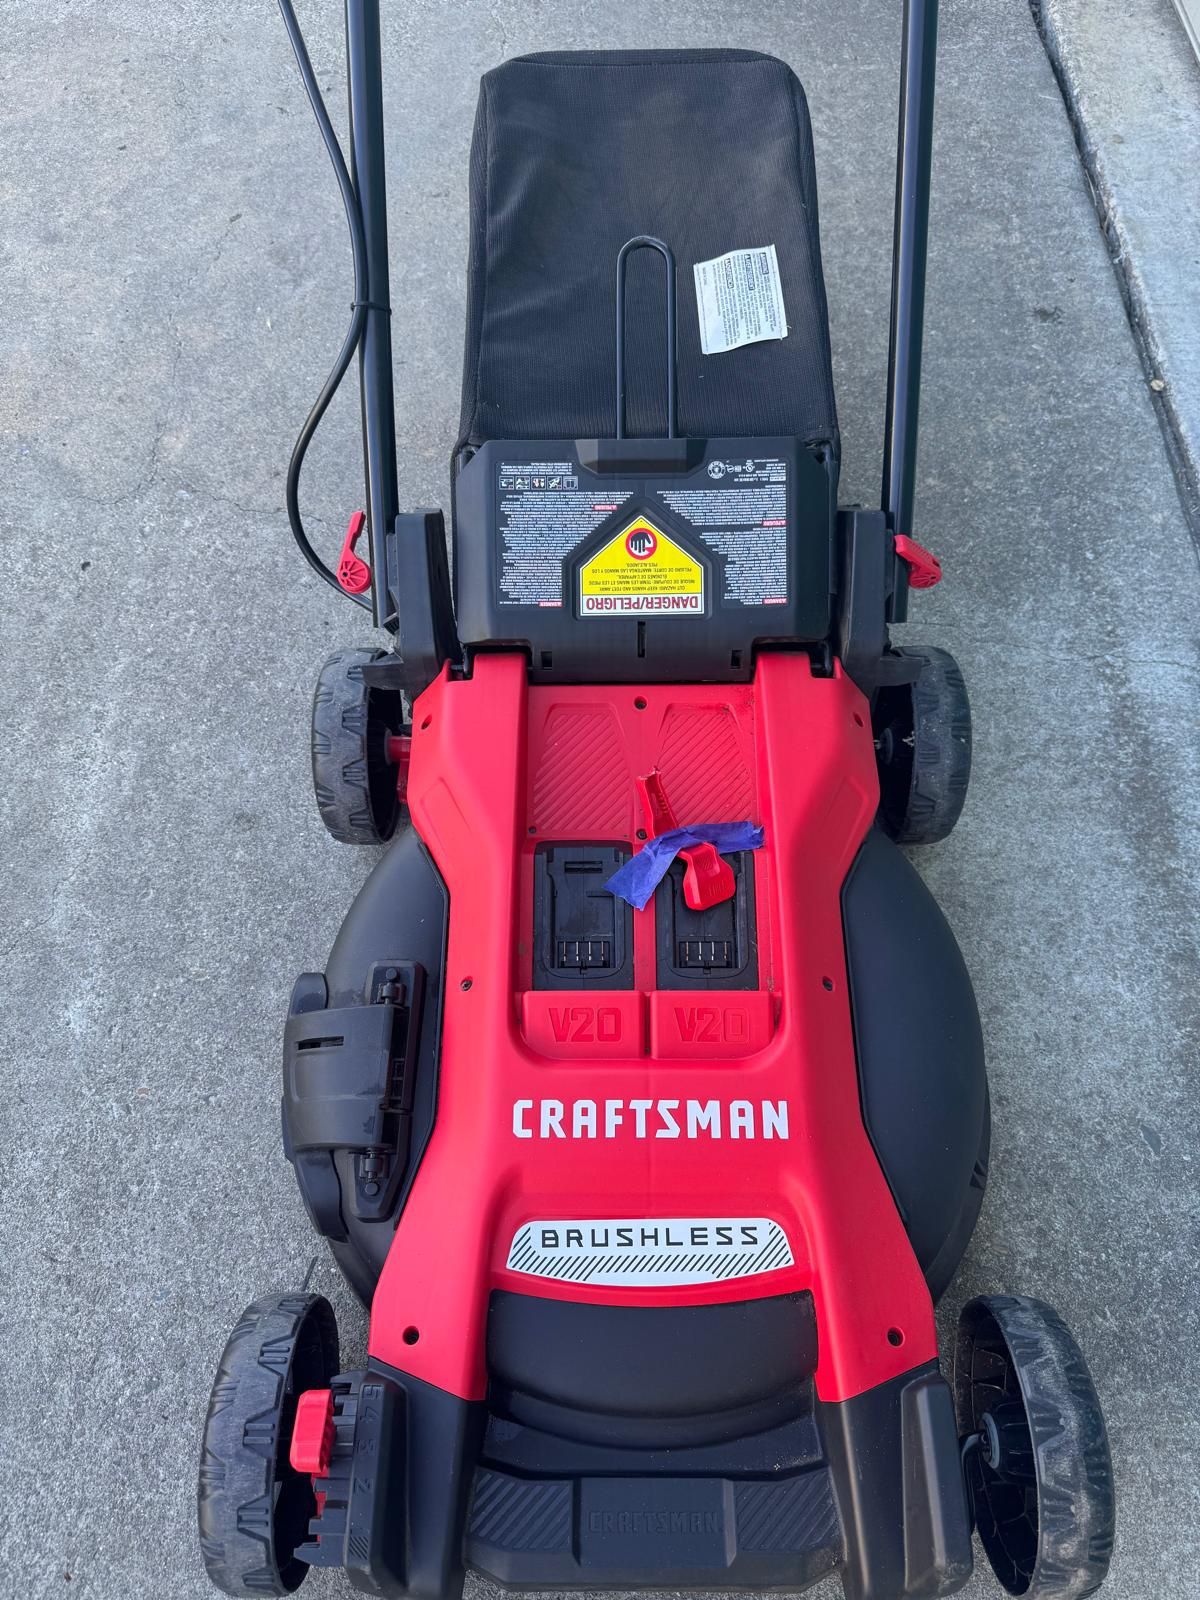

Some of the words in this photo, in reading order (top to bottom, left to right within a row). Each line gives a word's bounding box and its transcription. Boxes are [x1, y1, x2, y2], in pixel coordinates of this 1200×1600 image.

[586, 596, 699, 610] DANGER/PELIGRO
[549, 1007, 622, 1043] V20
[674, 1007, 749, 1043] V20
[512, 1099, 789, 1140] CRAFTSMAN
[541, 1226, 758, 1248] BRUSHLESS
[588, 1511, 719, 1534] CRAFTSMAN
